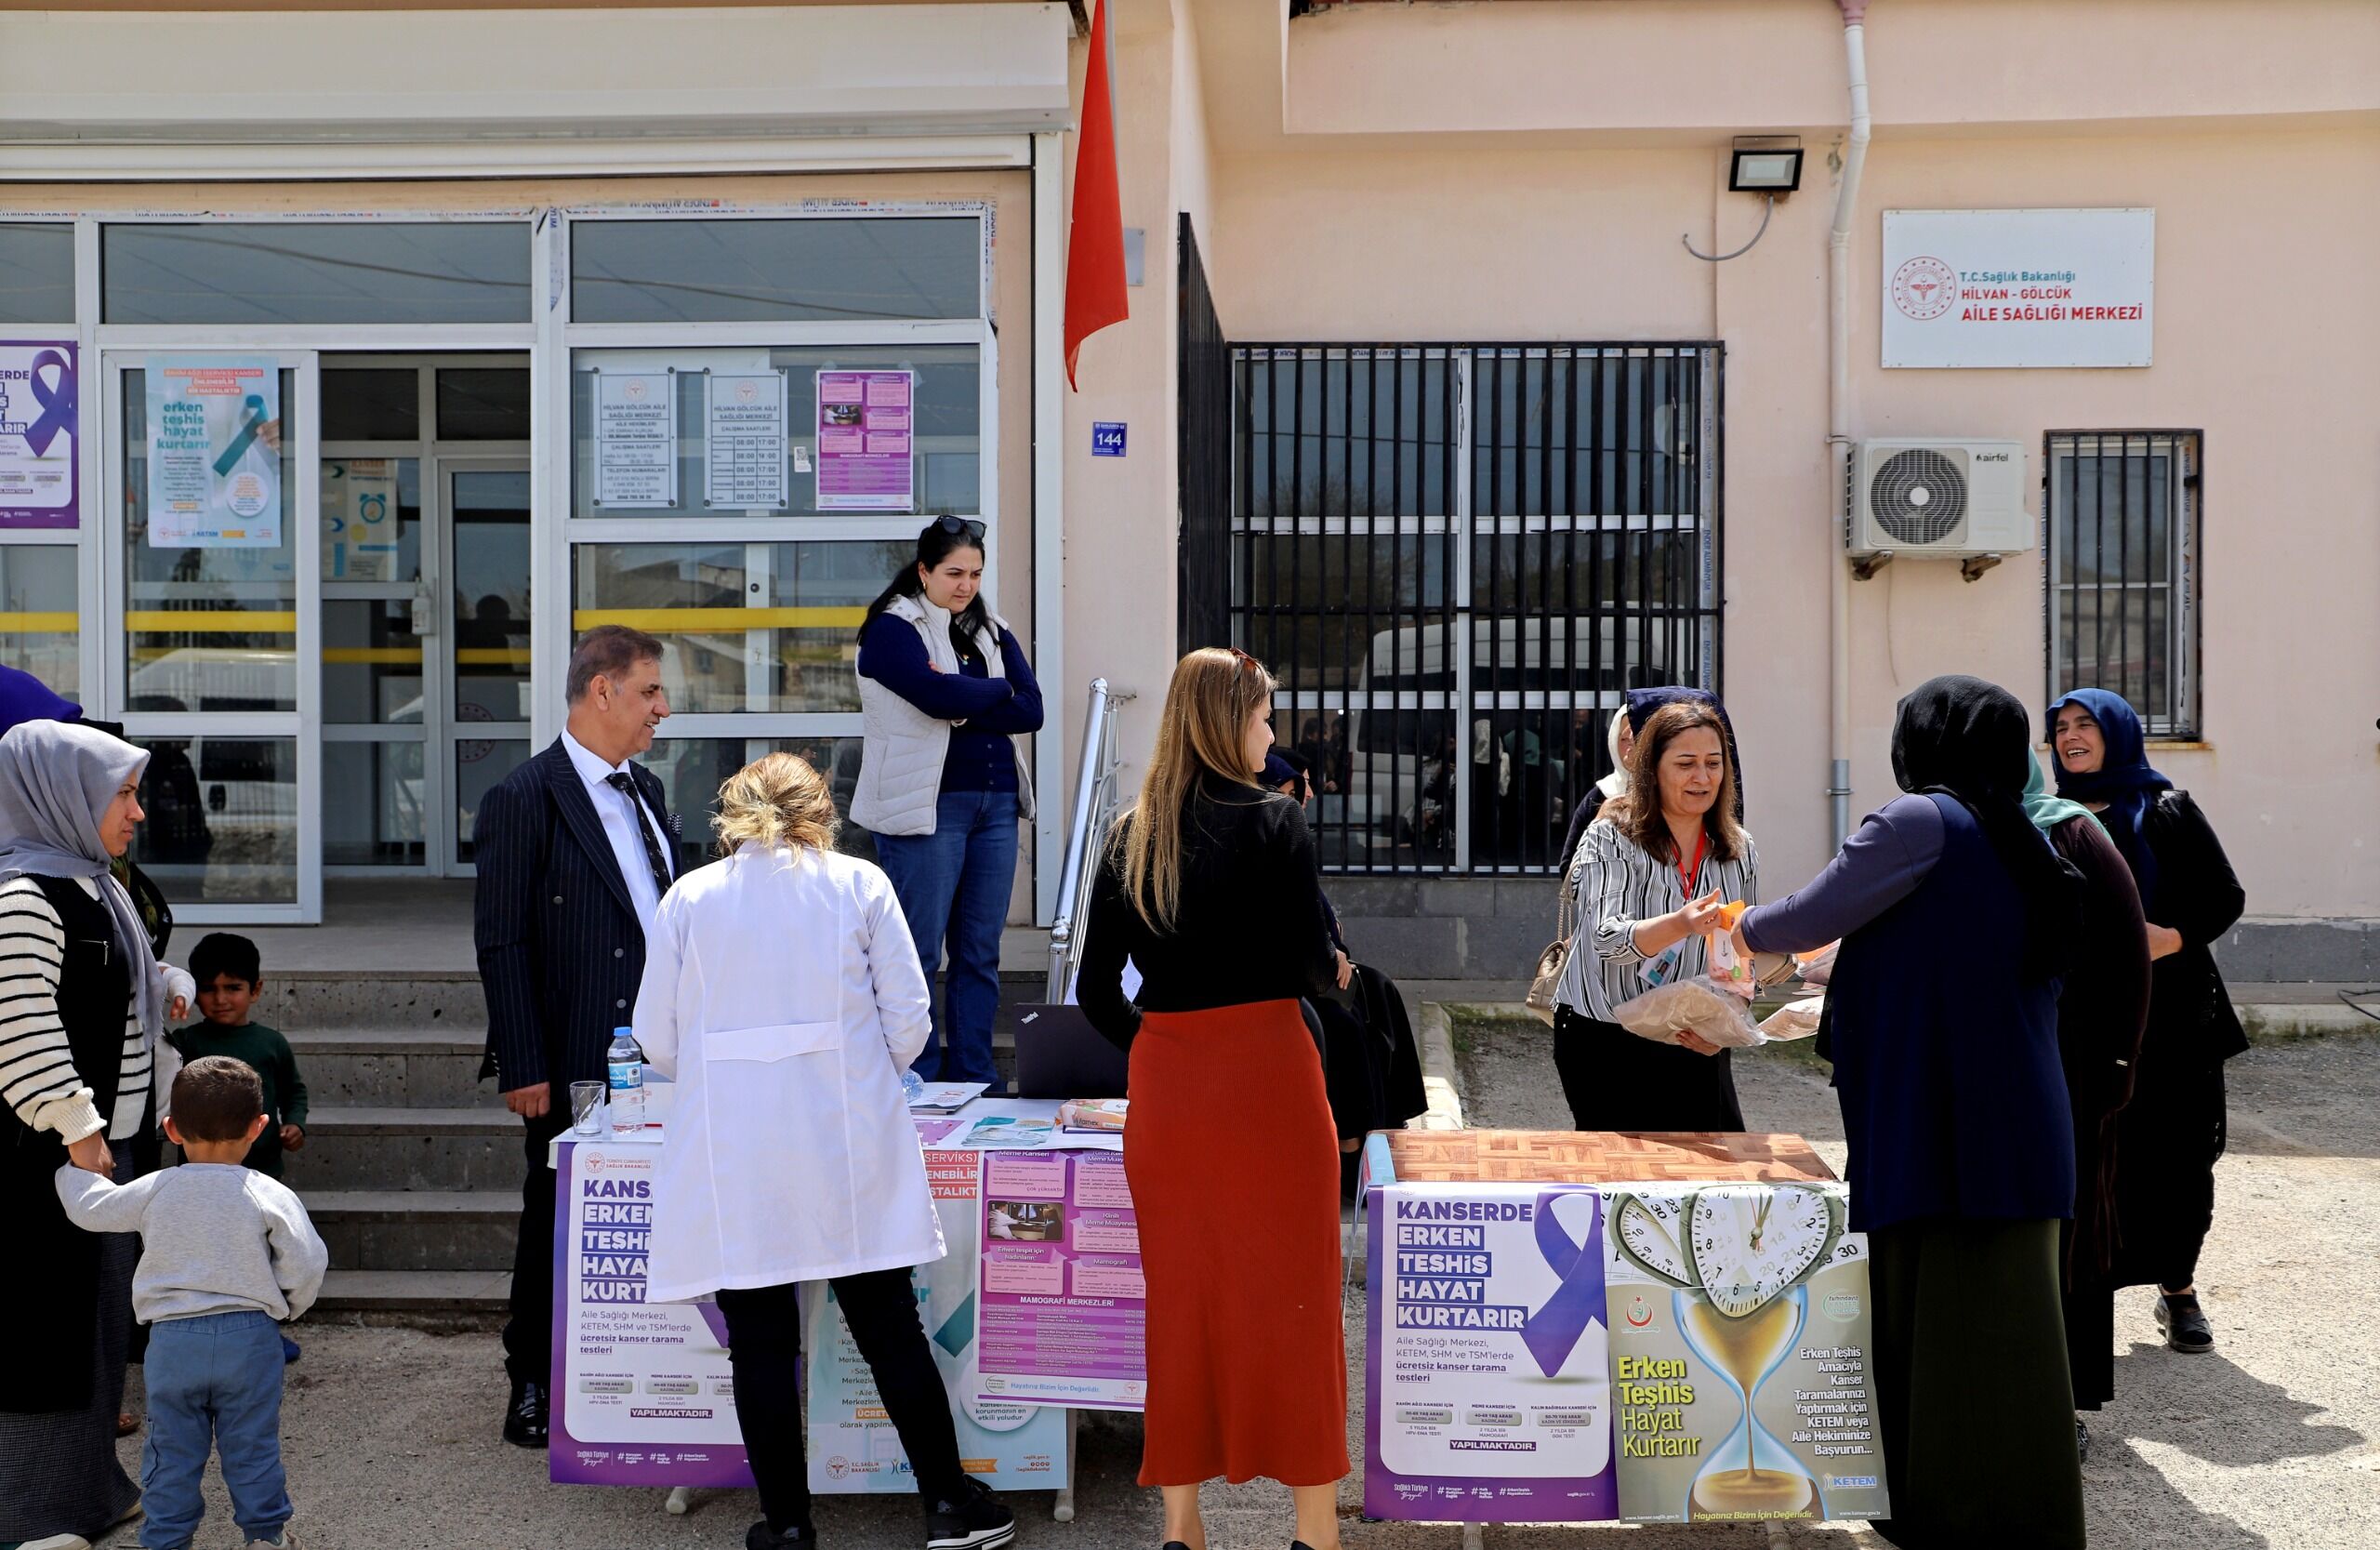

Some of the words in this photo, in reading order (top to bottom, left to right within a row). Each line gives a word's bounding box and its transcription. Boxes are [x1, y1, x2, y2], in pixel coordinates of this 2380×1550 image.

[2021, 271, 2076, 283] Bakanlığı
[1962, 286, 2008, 299] HİLVAN
[2020, 285, 2071, 299] GÖLCÜK
[1962, 304, 1998, 321] AİLE
[2003, 304, 2066, 321] SAĞLIĞI
[2071, 303, 2143, 321] MERKEZİ
[163, 402, 204, 413] erken
[164, 426, 204, 438] hayat
[156, 439, 210, 449] kurtarır
[1097, 432, 1122, 445] 144
[584, 1180, 653, 1199] KANS
[1396, 1200, 1533, 1222] KANSERDE
[1705, 1209, 1712, 1220] 9
[1806, 1218, 1817, 1229] 2
[1398, 1225, 1480, 1247] ERKEN
[1632, 1228, 1644, 1237] 10
[584, 1231, 650, 1251] TEŞHİ
[1705, 1238, 1712, 1250] 8
[1837, 1243, 1858, 1258] 30
[583, 1257, 648, 1276] HAYA
[1398, 1253, 1488, 1275] TEŞHİS
[1715, 1267, 1723, 1278] 7
[583, 1281, 646, 1301] KURT
[1398, 1279, 1482, 1301] HAYAT
[1733, 1283, 1739, 1296] 6
[1754, 1281, 1763, 1292] 5
[1020, 1295, 1065, 1305] MAMOGRAFİ
[1067, 1297, 1115, 1306] MERKEZLERİ
[601, 1311, 629, 1320] Sağlığı
[632, 1311, 668, 1320] Merkezi,
[1397, 1306, 1526, 1329] KURTARIR
[580, 1334, 616, 1343] ücretsiz
[1396, 1337, 1414, 1345] Aile
[1416, 1337, 1448, 1347] Sağlığı
[1450, 1338, 1489, 1348] Merkezi,
[580, 1345, 613, 1354] testleri
[1396, 1349, 1429, 1358] KETEM,
[1431, 1350, 1452, 1358] SHM
[1469, 1351, 1514, 1360] TSM'lerde
[1800, 1348, 1831, 1358] Erken
[1832, 1346, 1861, 1359] Teşhis
[1395, 1361, 1435, 1371] ücretsiz
[1436, 1362, 1469, 1371] kanser
[1472, 1364, 1507, 1372] tarama
[1618, 1356, 1686, 1380] Erken
[1818, 1360, 1862, 1373] Amacıyla
[1395, 1372, 1431, 1383] testleri
[1831, 1374, 1863, 1385] Kanser
[1618, 1381, 1694, 1411] Teşhis
[1794, 1389, 1866, 1400] Taramalarınızı
[631, 1410, 712, 1418] YAPILMAKTADIR.
[1795, 1403, 1848, 1415] Yaptırmak
[1850, 1402, 1868, 1415] için
[840, 1421, 863, 1429] olarak
[1621, 1407, 1683, 1436] Hayat
[1807, 1417, 1844, 1428] KETEM
[1846, 1418, 1869, 1429] veya
[1792, 1431, 1812, 1442] Aile
[1814, 1430, 1871, 1442] Hekiminize
[1450, 1440, 1536, 1451] YAPILMAKTADIR.
[1623, 1433, 1700, 1457] Kurtarır
[1815, 1444, 1873, 1458] Başvurun...
[1833, 1477, 1876, 1486] KETEM
[1693, 1512, 1732, 1521] Hayatınız
[1734, 1511, 1755, 1520] Bizim
[1757, 1509, 1771, 1521] İçin
[1773, 1510, 1814, 1521] Değerlidir.
